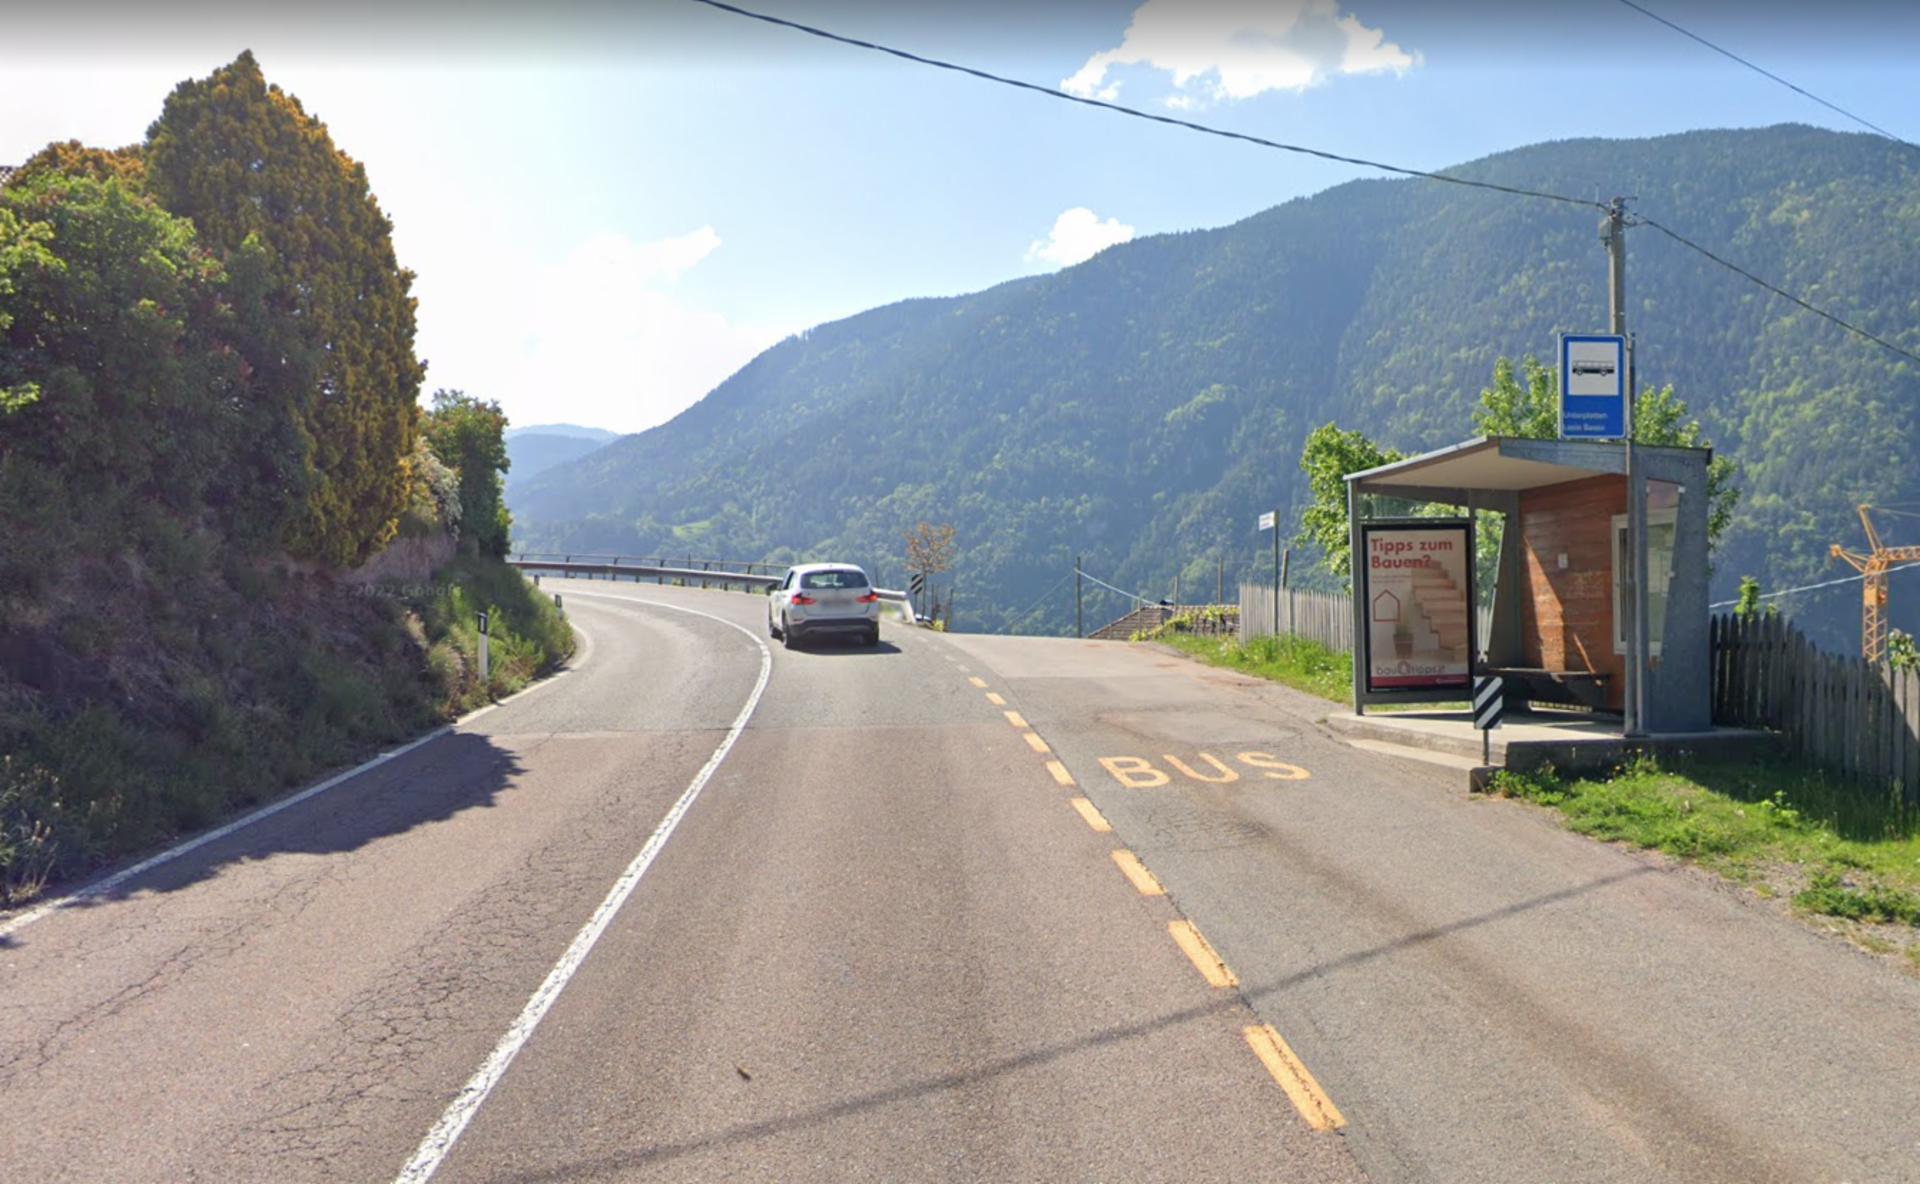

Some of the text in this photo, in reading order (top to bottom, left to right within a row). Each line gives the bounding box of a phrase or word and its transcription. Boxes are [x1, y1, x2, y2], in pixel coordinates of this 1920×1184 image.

[1371, 537, 1453, 555] Tipps zum
[1371, 555, 1432, 569] Bauen?
[1098, 751, 1312, 788] BUS
